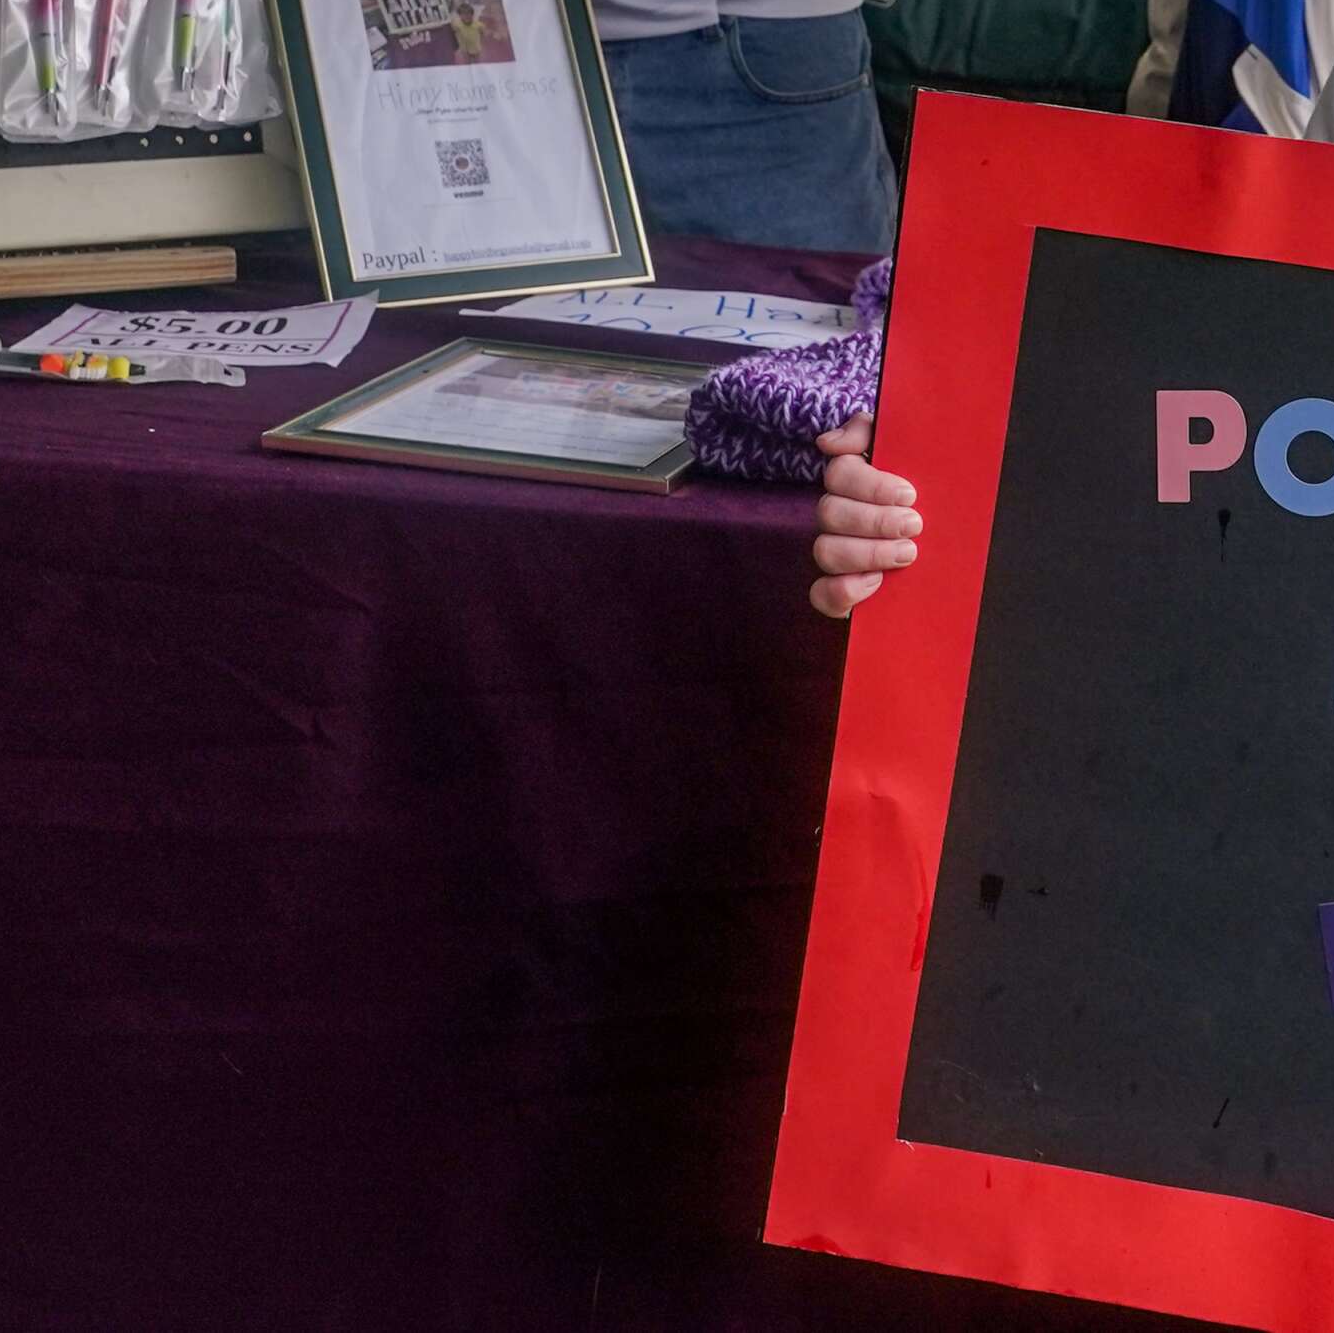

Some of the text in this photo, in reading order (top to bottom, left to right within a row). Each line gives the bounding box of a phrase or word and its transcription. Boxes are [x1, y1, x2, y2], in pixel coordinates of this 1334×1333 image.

[362, 246, 427, 271] Paypal
[118, 314, 289, 337] $5.00
[186, 339, 315, 355] PENS
